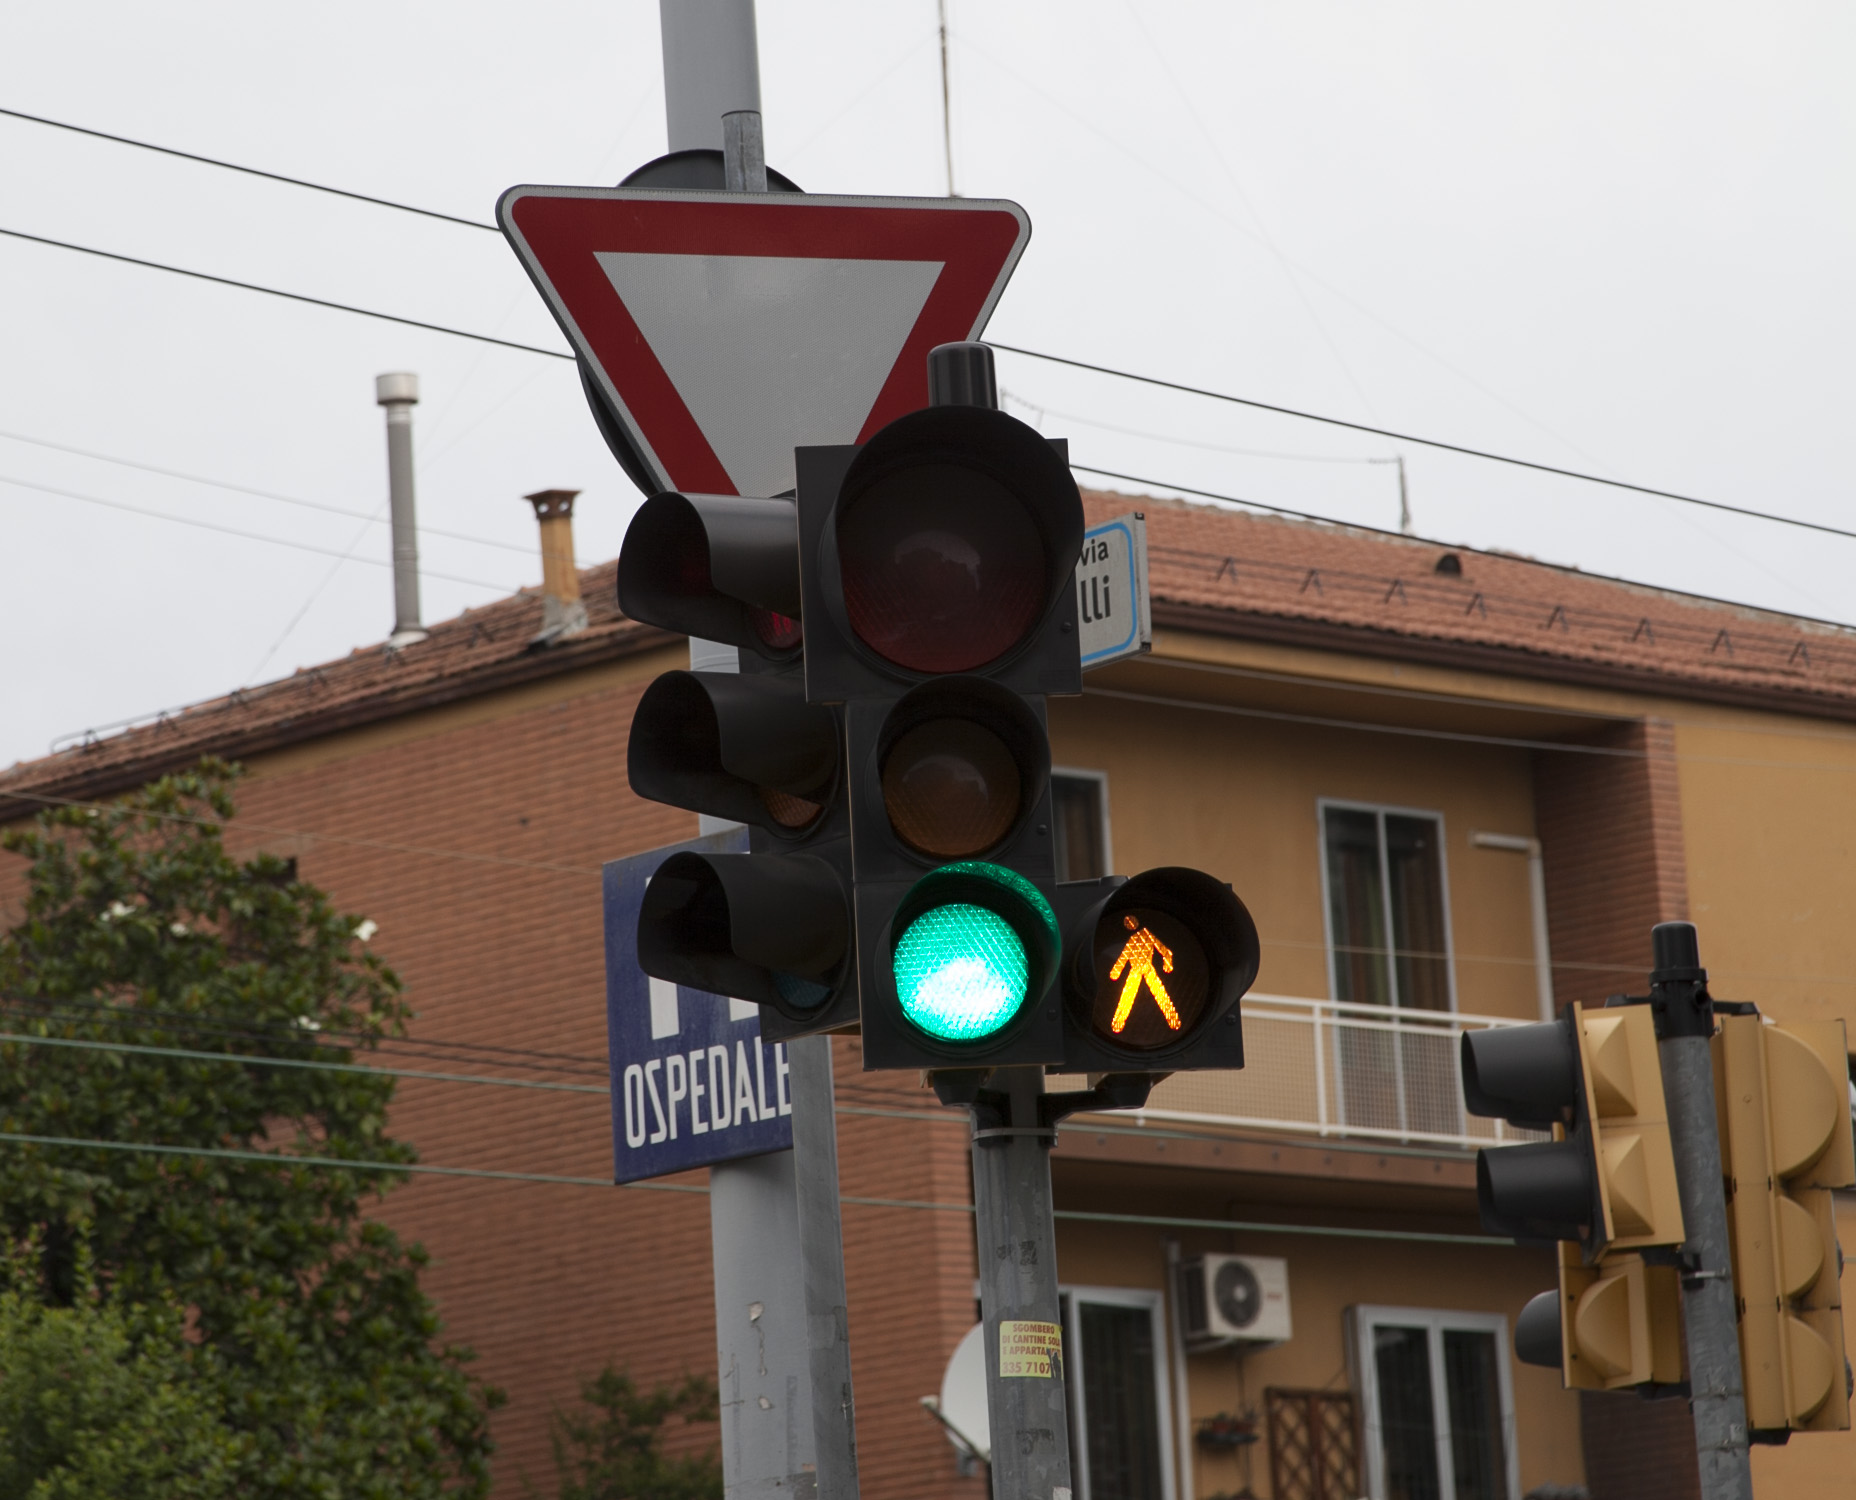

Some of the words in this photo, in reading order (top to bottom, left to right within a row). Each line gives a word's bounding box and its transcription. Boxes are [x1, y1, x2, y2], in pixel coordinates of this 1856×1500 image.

[1081, 539, 1109, 566] via
[624, 1035, 792, 1149] OSPEDALE
[1013, 1324, 1054, 1334] SGOMBERO
[1002, 1335, 1010, 1344] DI
[1013, 1335, 1046, 1344] CANTINE
[1002, 1346, 1007, 1356] E
[1002, 1361, 1022, 1374] 335
